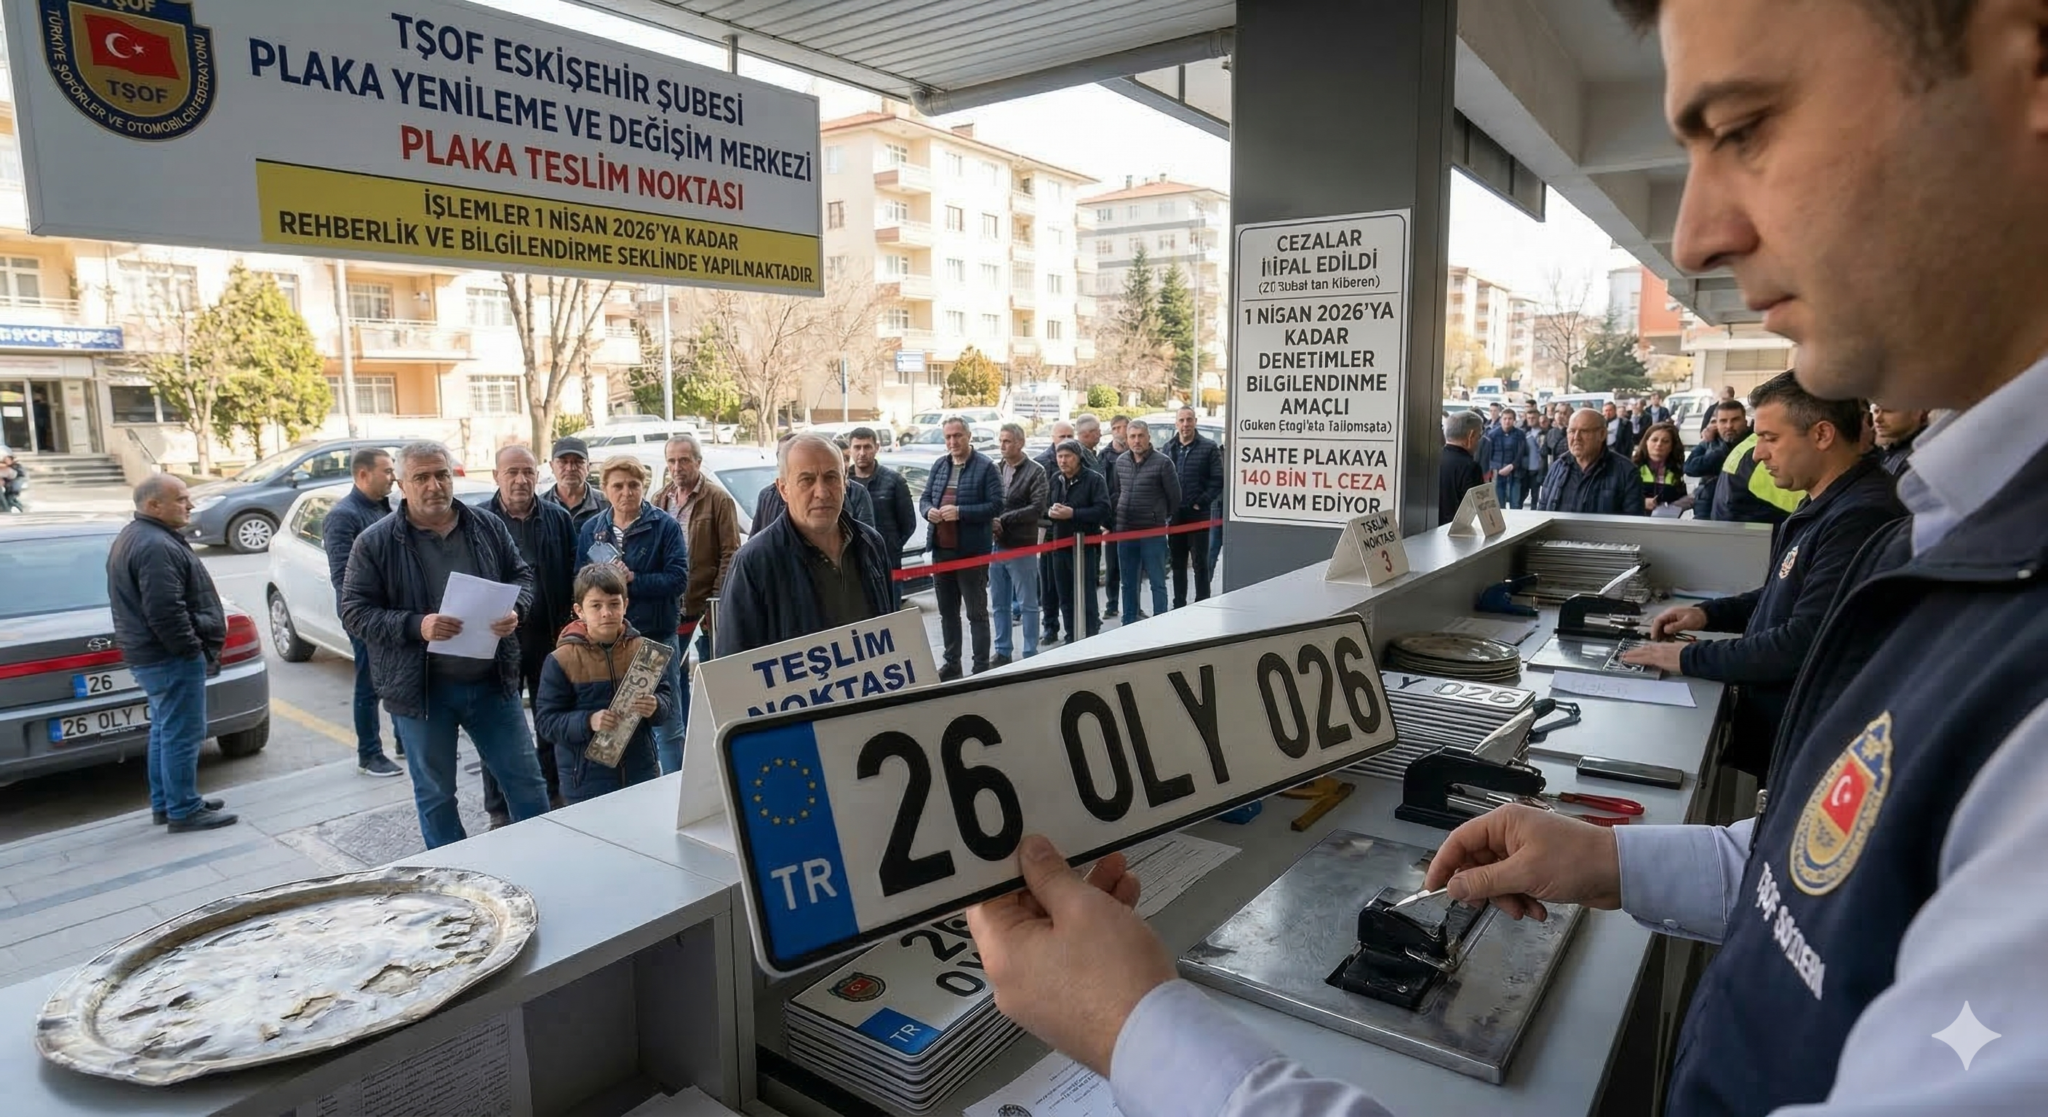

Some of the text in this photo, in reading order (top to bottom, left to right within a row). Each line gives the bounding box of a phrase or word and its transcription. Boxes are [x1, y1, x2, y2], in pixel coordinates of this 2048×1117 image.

[391, 12, 744, 127] TŞOF ESKİŞEHİR ŞUBESİ
[53, 64, 106, 119] ŞOFÖRLER
[108, 114, 125, 128] VE
[106, 80, 168, 104] TŞOF
[249, 37, 812, 182] PLAKA YENİLEME VE DEĞİŞİM MERKEZİ
[401, 124, 744, 211] PLAKA TESLİM NOKTASI
[424, 188, 739, 251] İŞLEMLER 1 NİSAN 2026'YA KADAR
[279, 210, 420, 247] REHBERLİK
[425, 225, 455, 249] VE
[461, 226, 613, 265] BİLGİLENDİRME
[618, 246, 698, 272] SEKLİNDE
[1277, 229, 1362, 252] CEZALAR
[1317, 248, 1378, 273] EDİLDİ
[1311, 279, 1329, 290] tan
[1245, 308, 1251, 325] 1
[1317, 301, 1394, 322] 2026'YA
[1285, 327, 1349, 346] KADAR
[1280, 398, 1349, 417] AMAÇLI
[1241, 447, 1388, 467] SAHTE PLAKAYA
[1241, 467, 1387, 491] 140 BİN TL CEZA
[1246, 491, 1381, 514] DEVAM EDİYOR
[1381, 550, 1393, 573] 3
[752, 628, 895, 689] TEŞLİM
[89, 674, 113, 693] 26
[63, 717, 88, 737] 26
[855, 713, 1024, 897] 26
[770, 856, 838, 910] TR
[890, 1023, 921, 1043] TR
